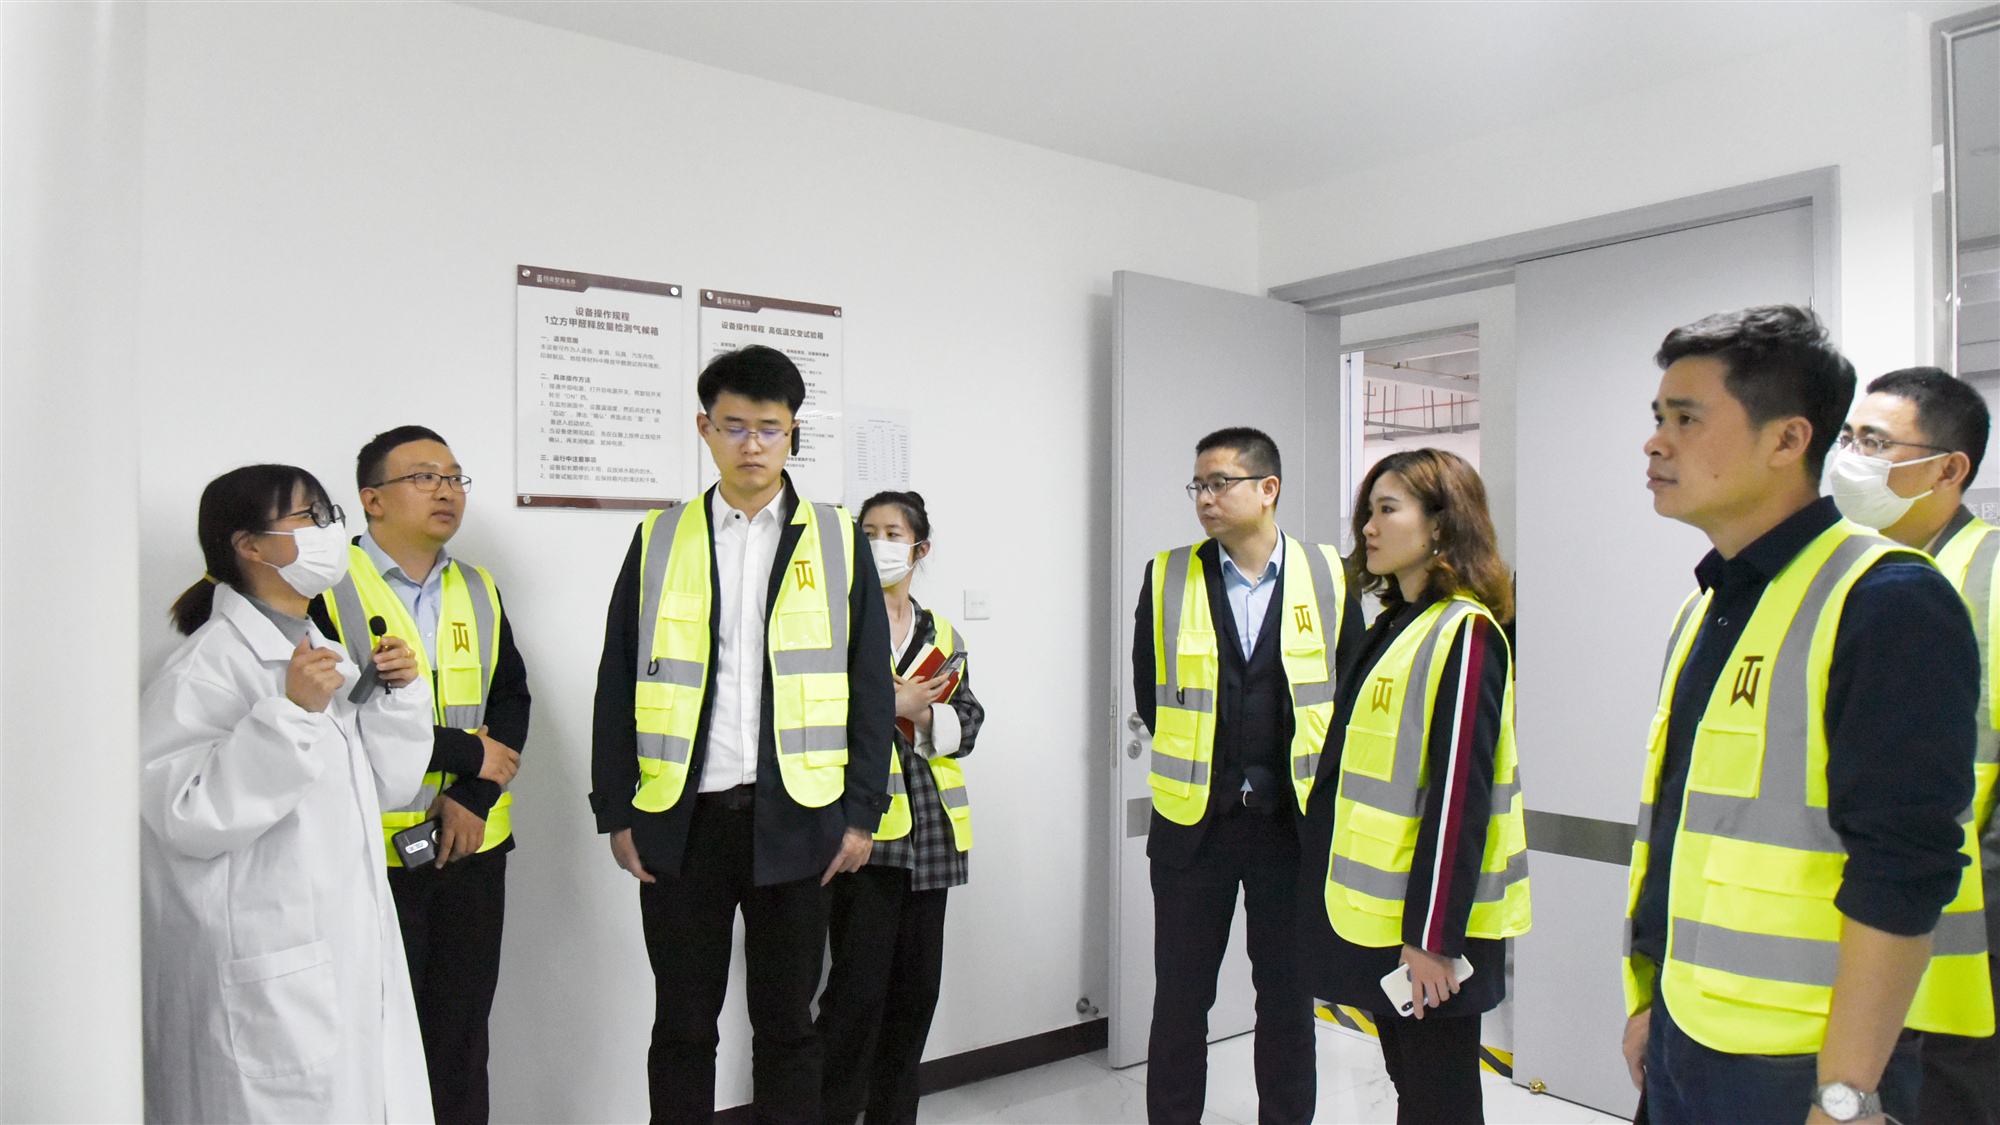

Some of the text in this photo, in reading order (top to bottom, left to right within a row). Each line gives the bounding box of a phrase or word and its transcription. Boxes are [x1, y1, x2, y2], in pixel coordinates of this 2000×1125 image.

[575, 306, 630, 321] 设备操作规程
[544, 315, 659, 336] 1立方甲醛释放量检测气候箱
[721, 321, 824, 340] 设备操作规程 高低温交变试验箱
